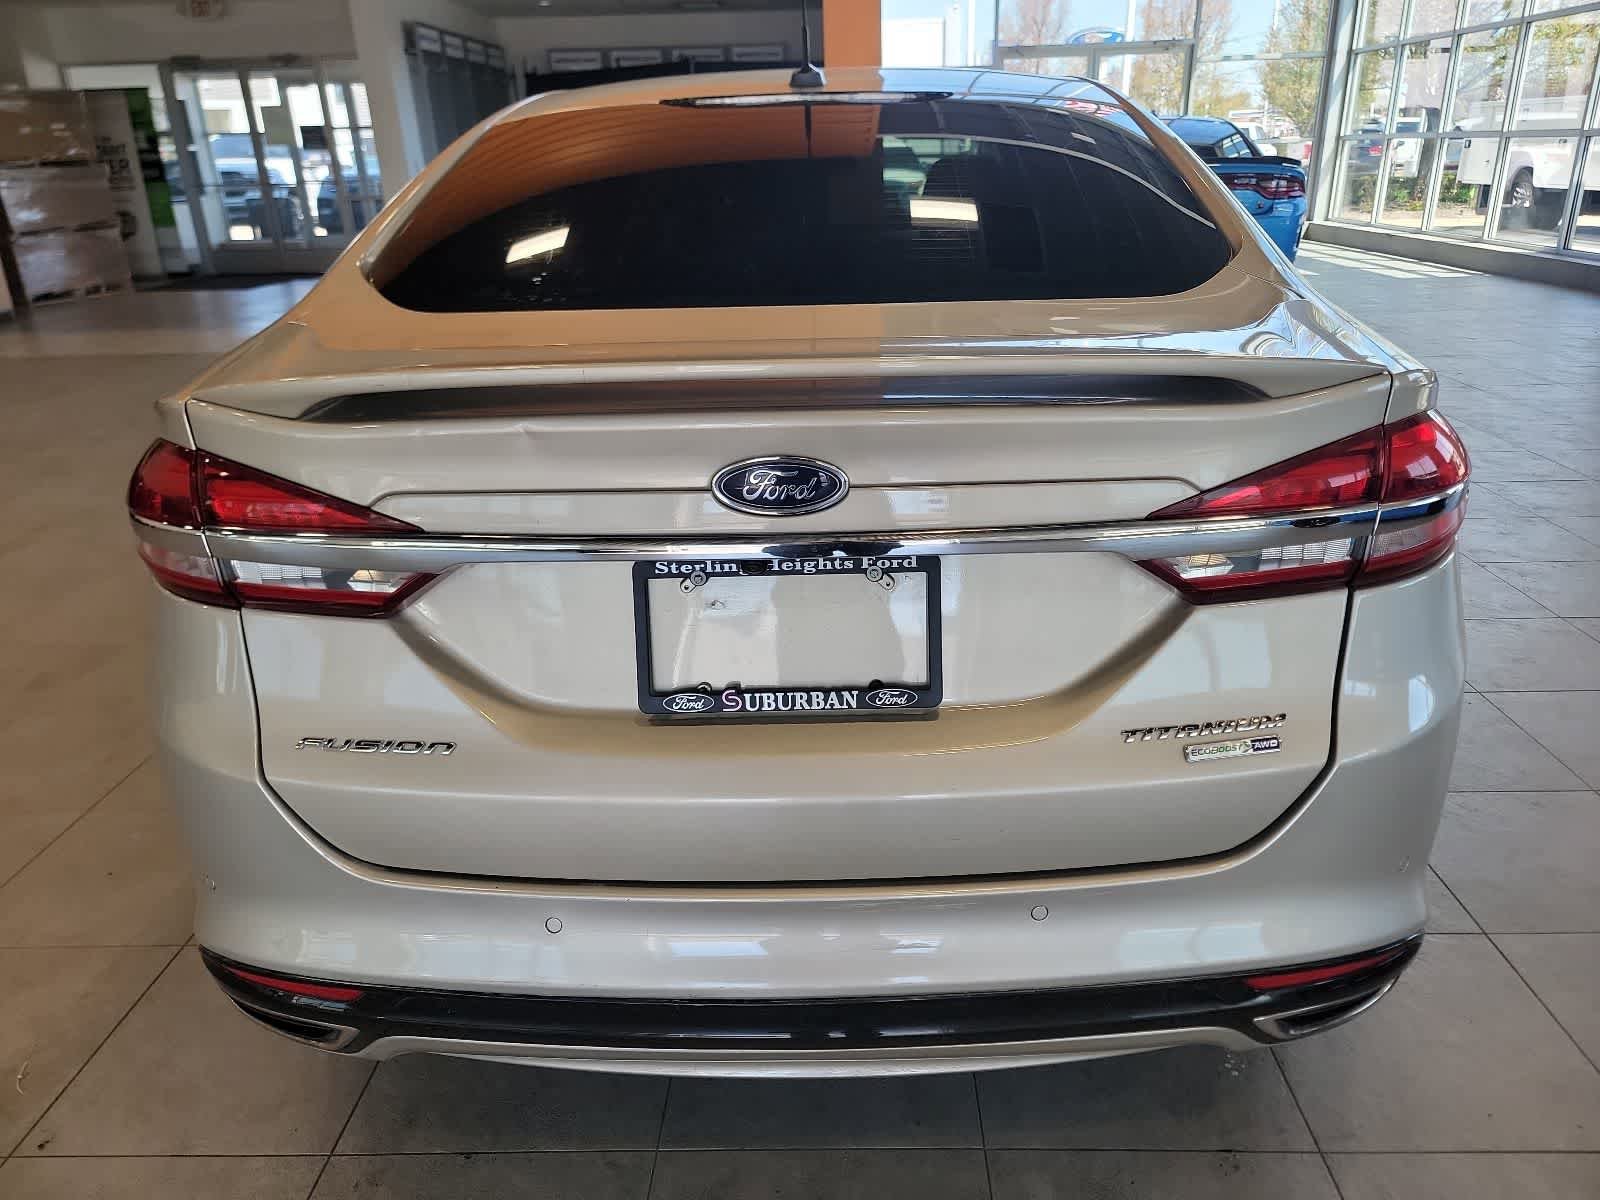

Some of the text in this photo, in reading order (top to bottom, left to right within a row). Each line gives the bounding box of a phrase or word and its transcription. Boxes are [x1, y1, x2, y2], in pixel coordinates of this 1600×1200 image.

[742, 470, 817, 500] Ford
[655, 560, 750, 576] Sterlin
[861, 555, 917, 569] Ford
[672, 689, 908, 712] Ford SUBURBAN Ford
[1121, 713, 1286, 743] TITANIUM
[296, 737, 456, 755] FUSION
[1253, 739, 1278, 750] AWD
